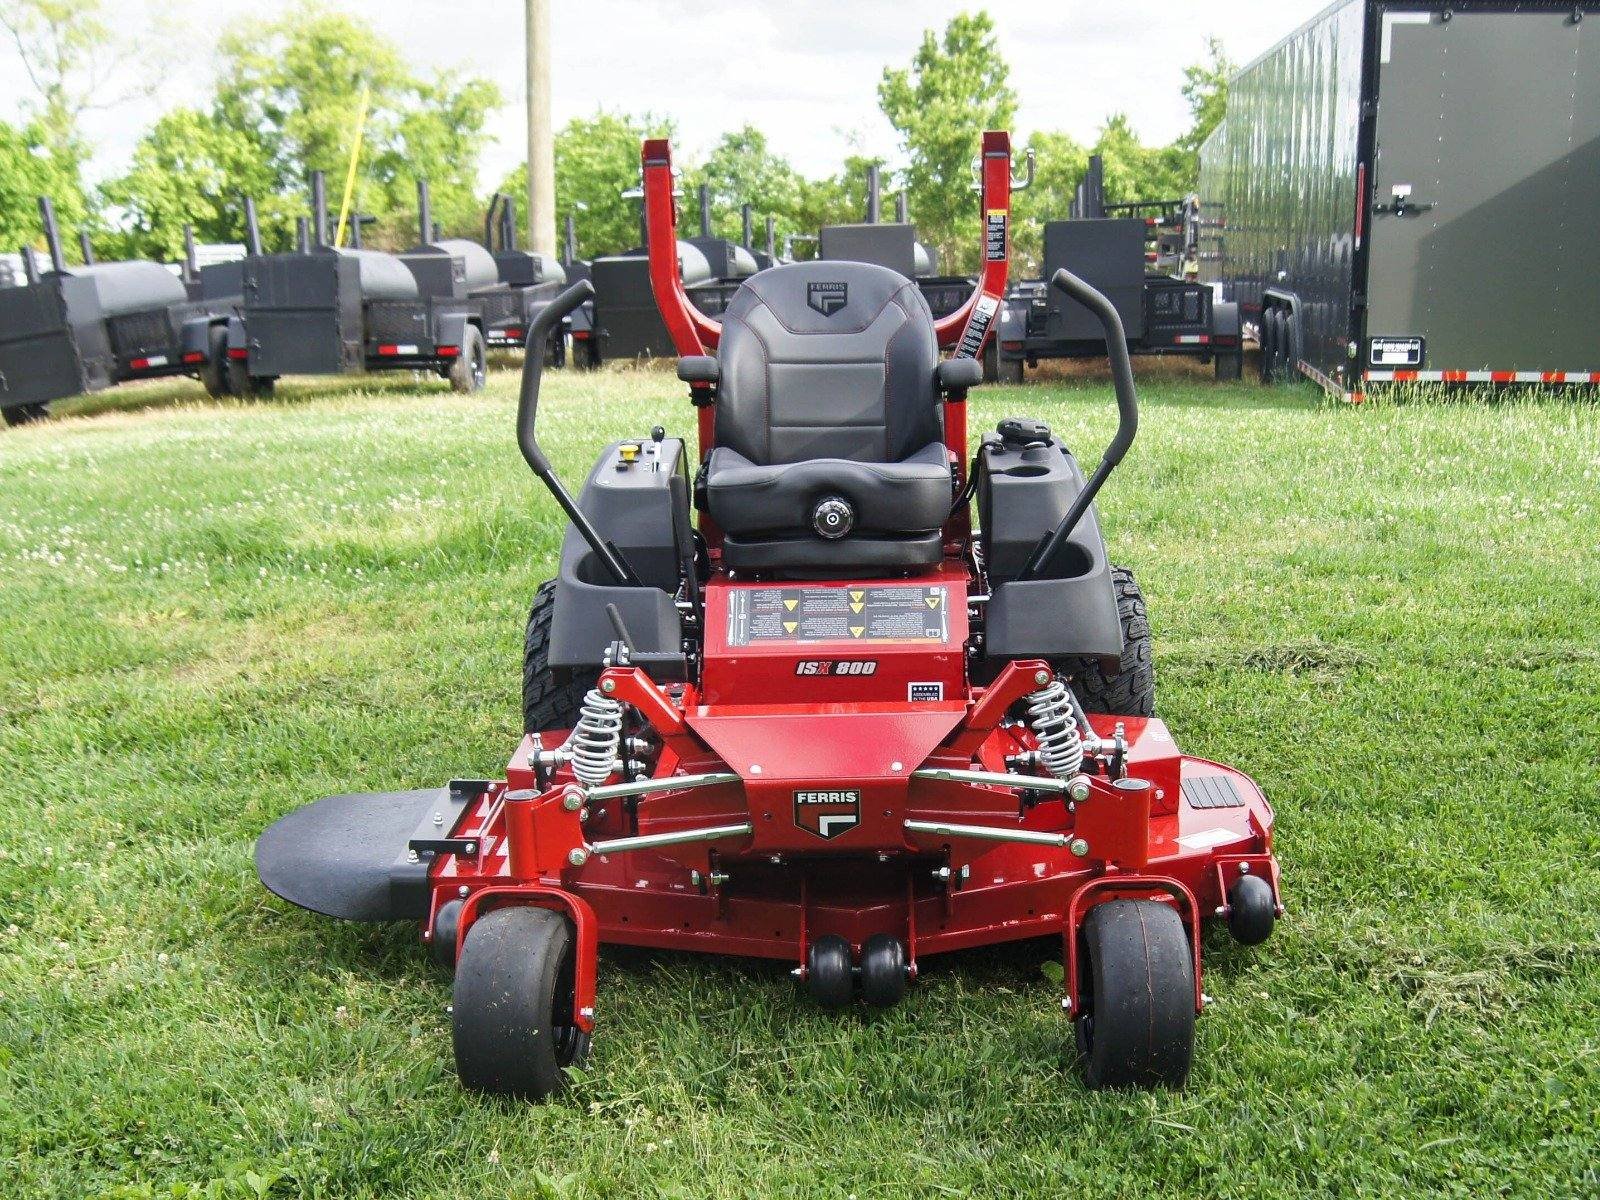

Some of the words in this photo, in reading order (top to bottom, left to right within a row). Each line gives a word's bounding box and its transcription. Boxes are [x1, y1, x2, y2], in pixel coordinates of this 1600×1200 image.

[796, 661, 832, 675] ISX
[836, 661, 877, 675] 800
[797, 792, 857, 803] FERRIS
